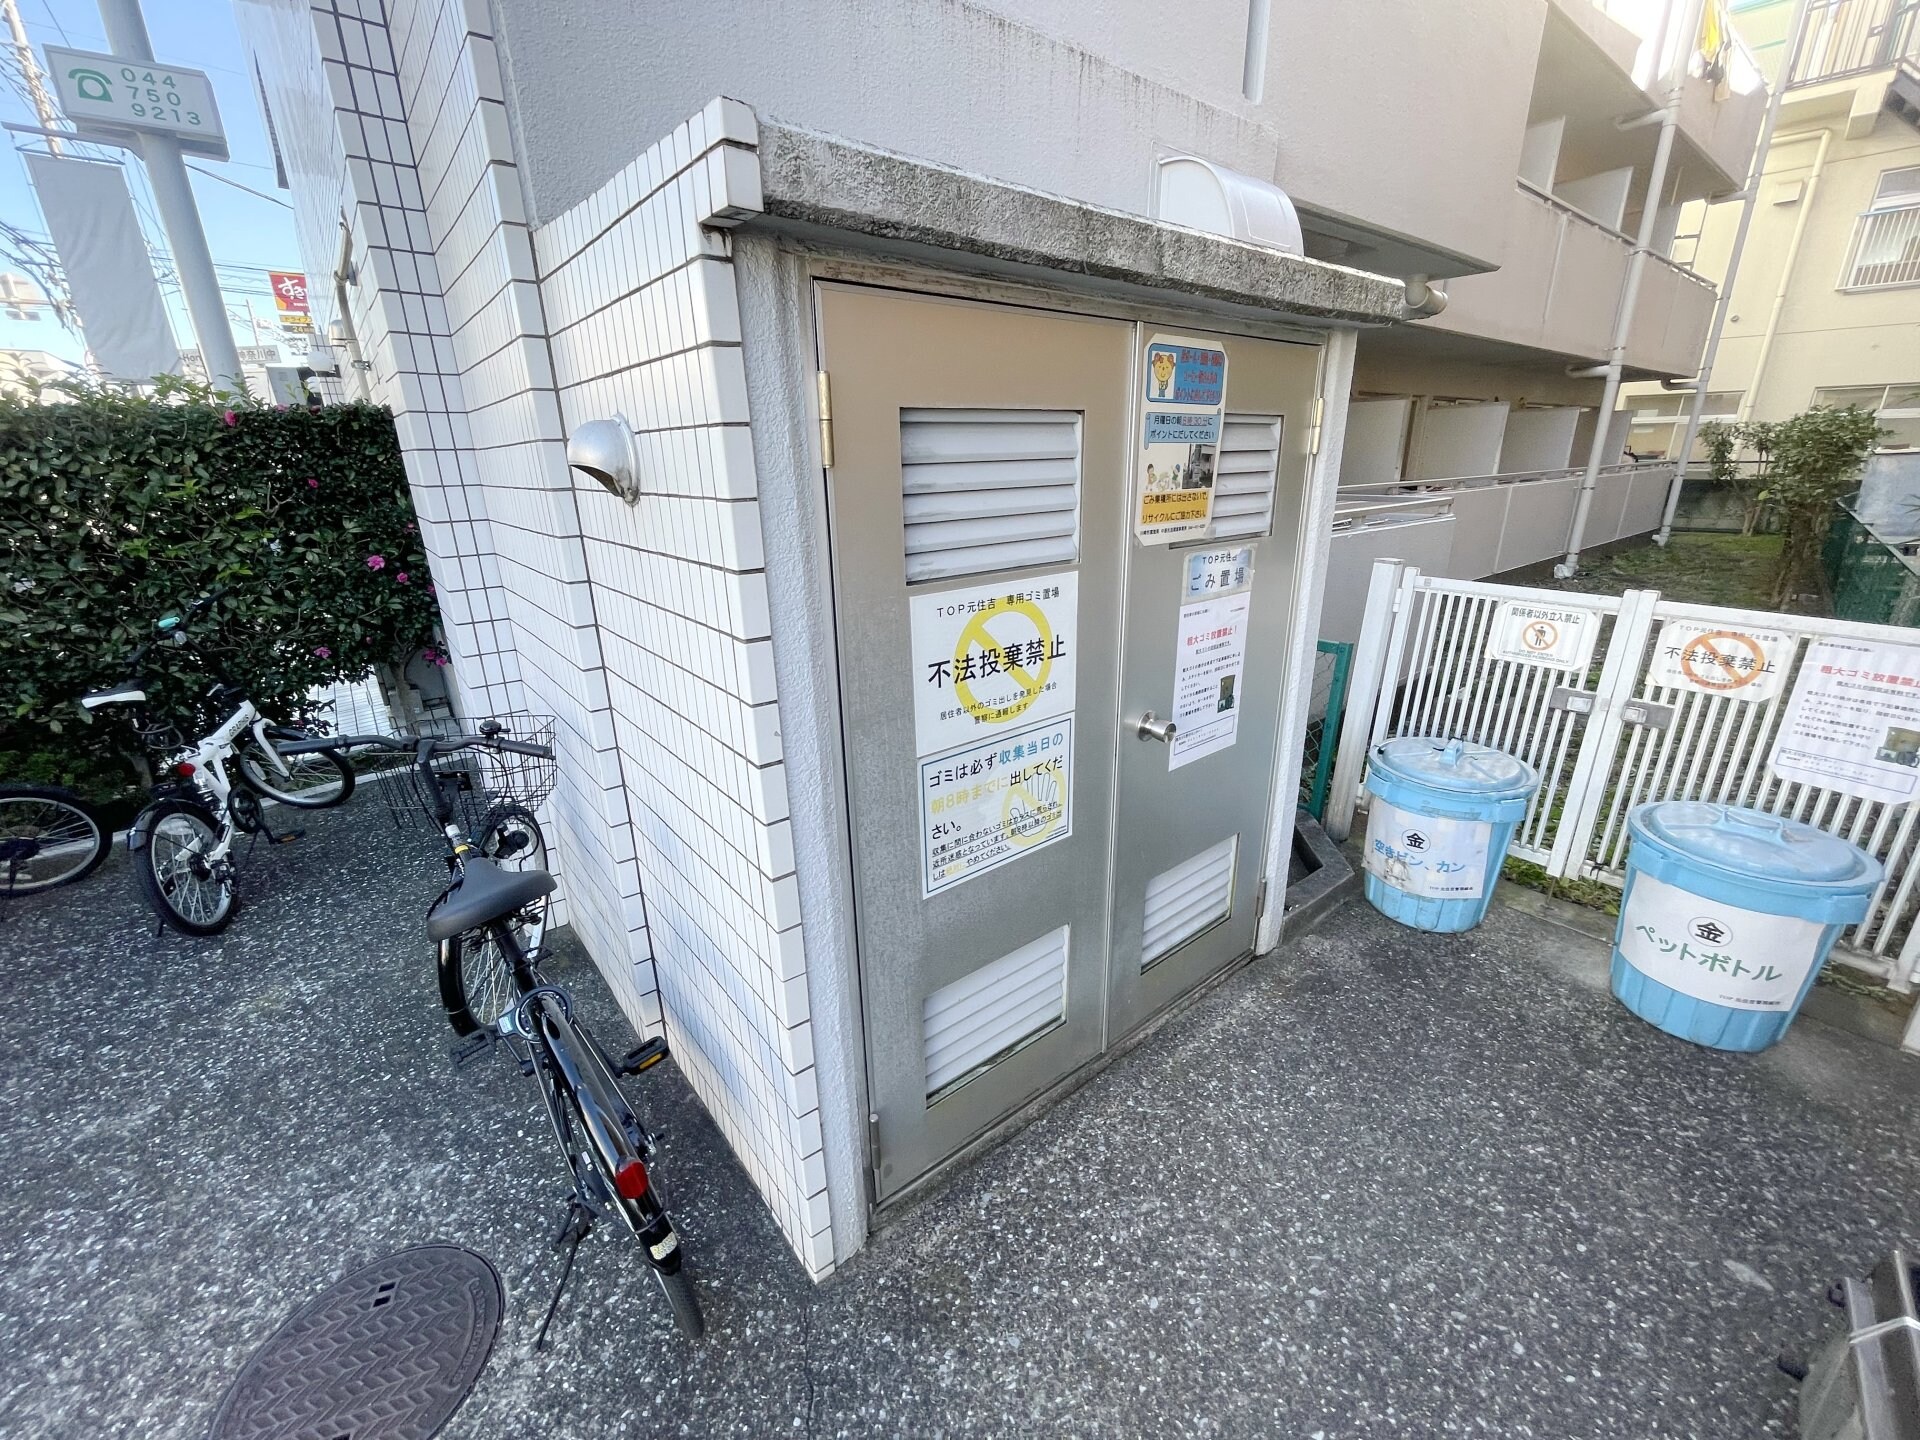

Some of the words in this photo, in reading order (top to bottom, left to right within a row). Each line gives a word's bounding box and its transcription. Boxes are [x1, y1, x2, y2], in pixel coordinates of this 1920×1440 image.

[121, 68, 176, 89] 044
[126, 85, 181, 106] 750
[132, 103, 201, 126] 9213
[278, 277, 308, 300] すき
[1150, 429, 1214, 439] ポイントにだしてください
[937, 597, 996, 618] TOP元住吉
[1006, 586, 1060, 607] 専用ゴミ置場
[1511, 607, 1581, 625] 関係者以外立入禁止
[928, 634, 1067, 688] 不法投棄禁止
[1664, 646, 1776, 674] 不法投棄禁止
[940, 681, 1057, 721] 居住者以外のゴミ出しを発見した場合
[929, 732, 1064, 788] ゴミは必ず収集当日の
[930, 754, 1064, 815] 朝8時までに出してくだ
[932, 820, 962, 840] さい。
[1406, 832, 1426, 850] 金
[1374, 838, 1467, 874] 空きビン、カン
[1694, 921, 1726, 944] 金
[1636, 925, 1783, 982] ペットボトル
